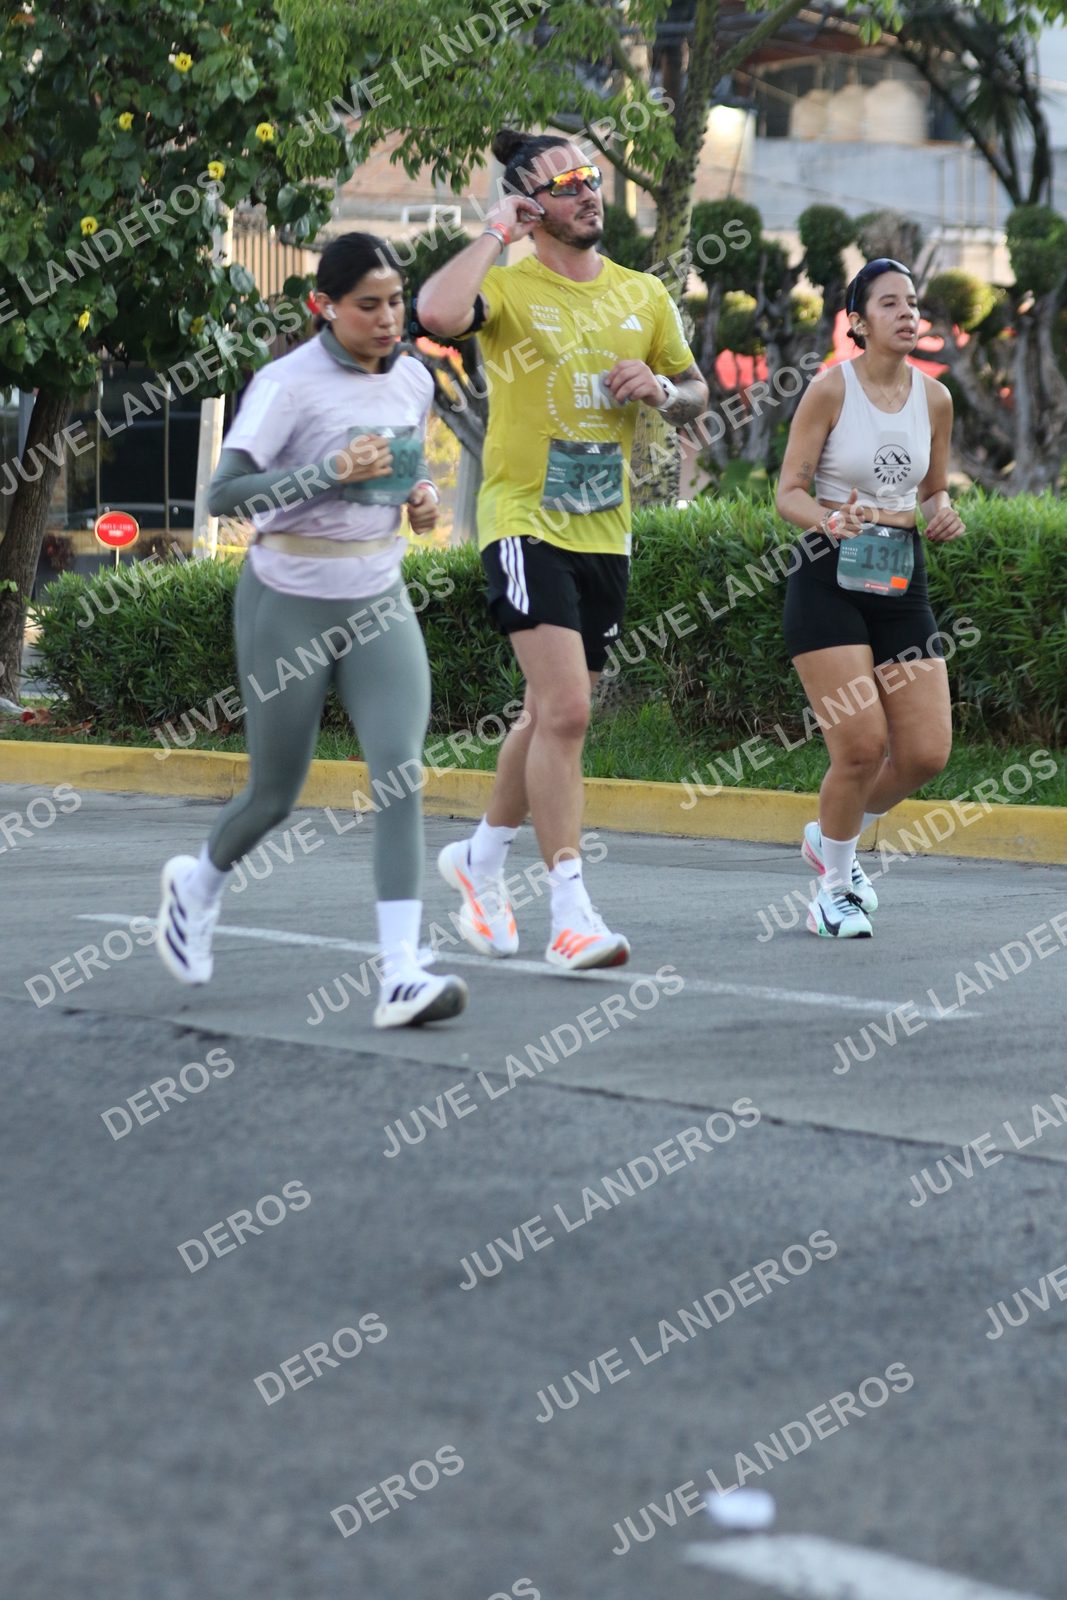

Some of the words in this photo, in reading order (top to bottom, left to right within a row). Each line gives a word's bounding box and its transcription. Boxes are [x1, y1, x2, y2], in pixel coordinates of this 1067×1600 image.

[573, 372, 588, 386] 15
[575, 394, 590, 409] 30
[874, 466, 911, 484] MANIACOS
